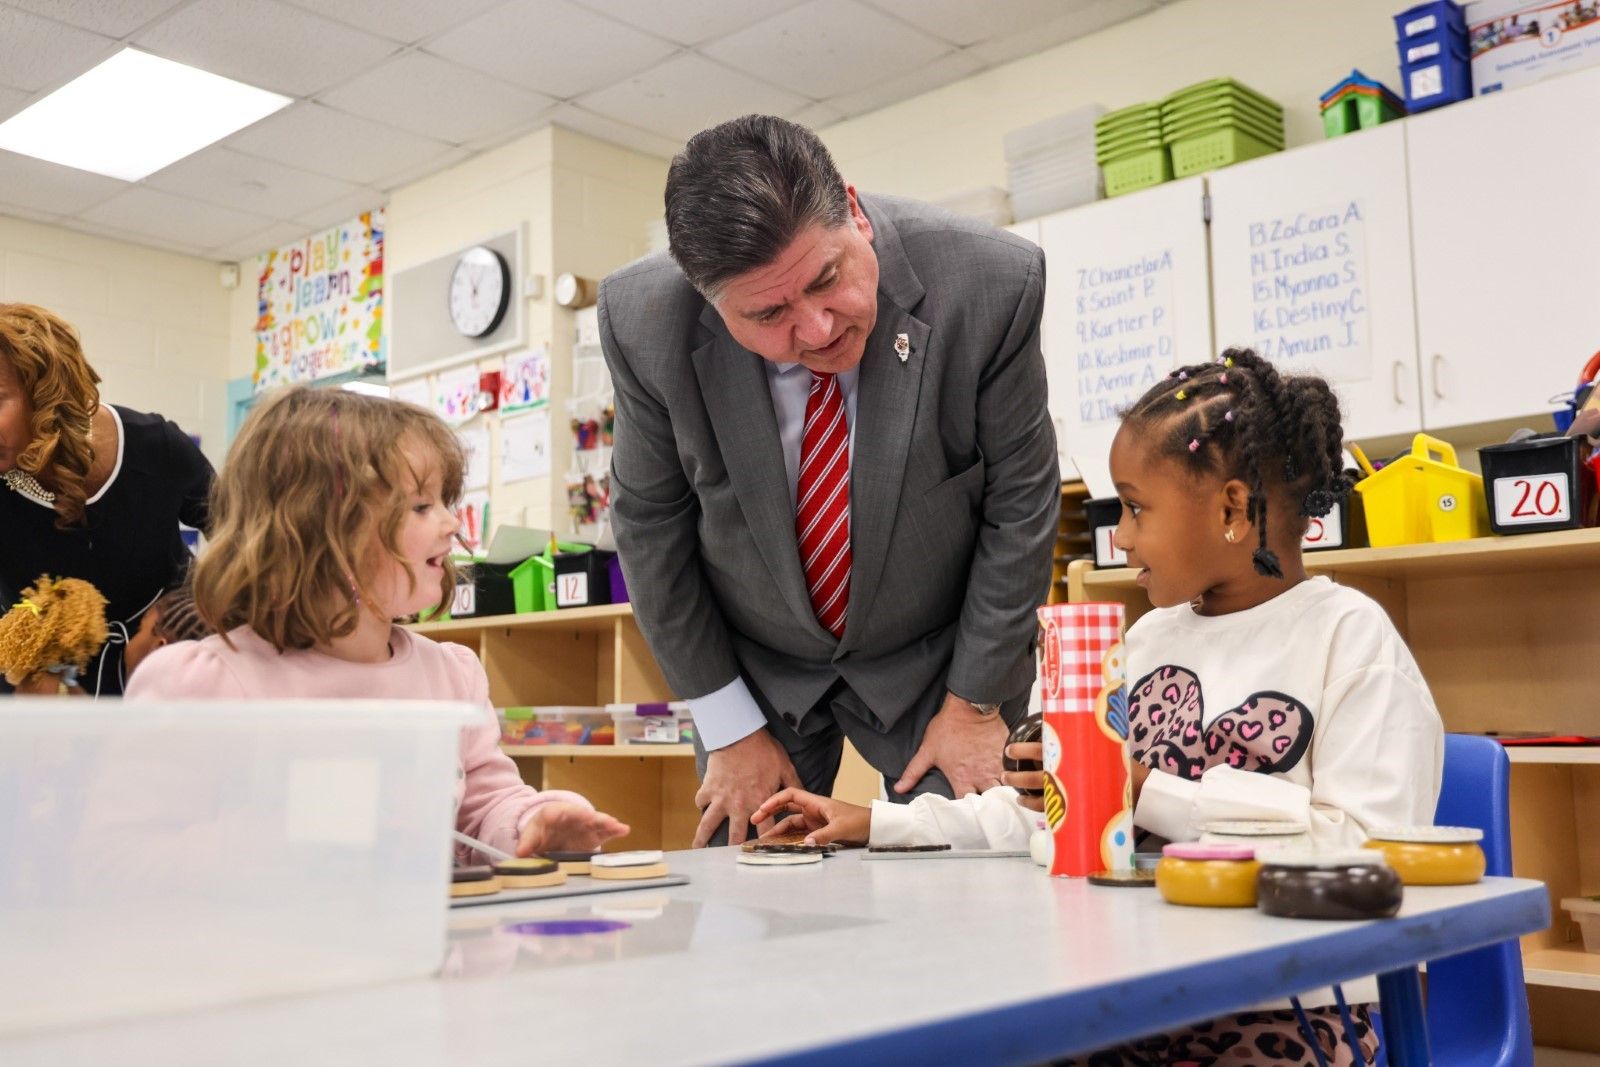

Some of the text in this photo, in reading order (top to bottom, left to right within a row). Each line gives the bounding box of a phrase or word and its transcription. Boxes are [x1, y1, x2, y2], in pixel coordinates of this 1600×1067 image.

[288, 228, 341, 294] play
[1270, 242, 1329, 272] India
[295, 269, 352, 314] learn
[1089, 282, 1135, 312] Saint
[1275, 297, 1350, 328] Destiny
[282, 306, 339, 366] grow
[1090, 314, 1149, 342] Kartier
[291, 340, 359, 379] together
[1441, 497, 1454, 509] 15
[564, 575, 582, 600] 12
